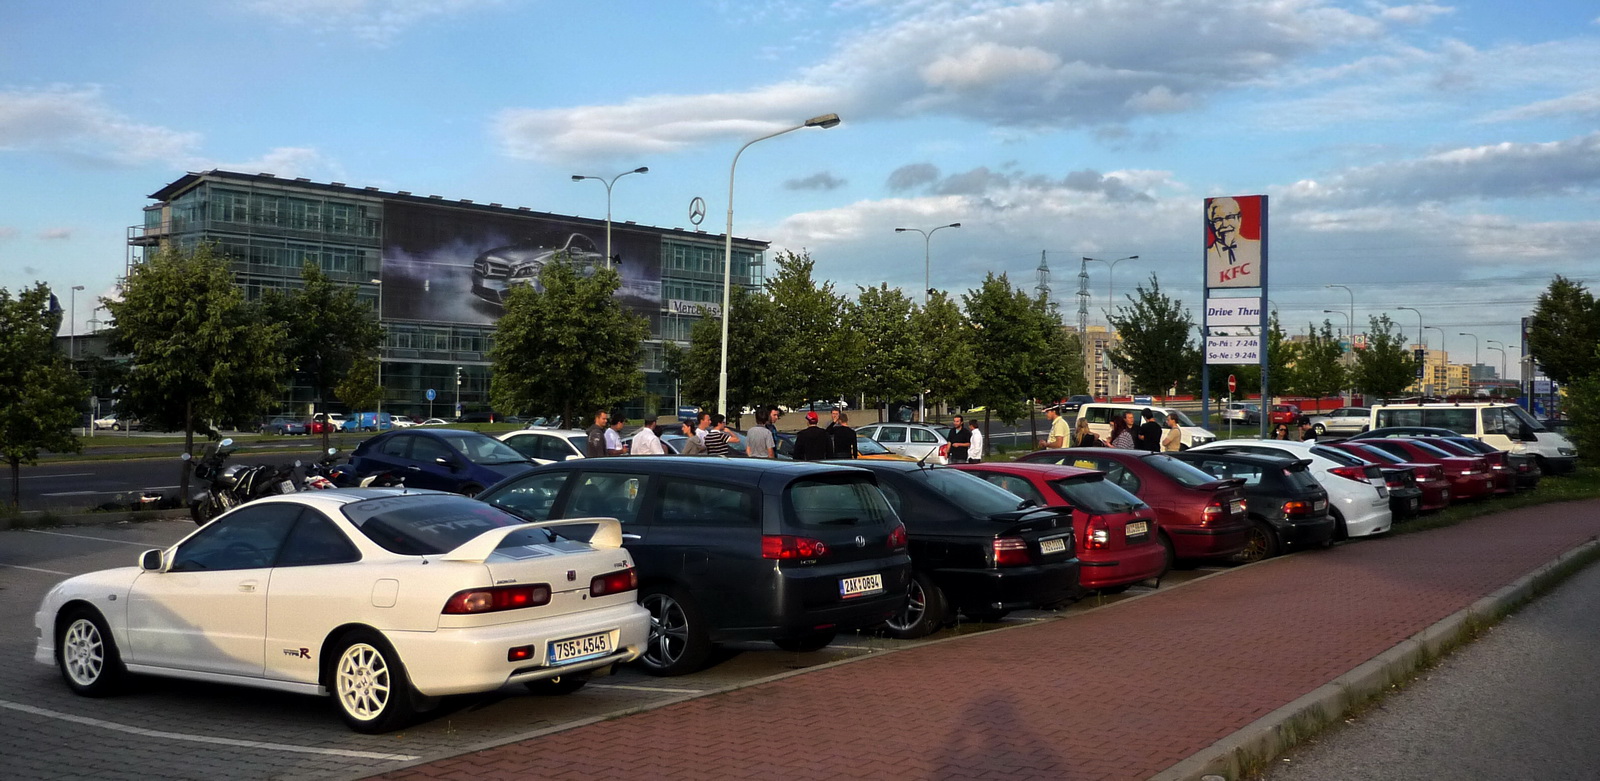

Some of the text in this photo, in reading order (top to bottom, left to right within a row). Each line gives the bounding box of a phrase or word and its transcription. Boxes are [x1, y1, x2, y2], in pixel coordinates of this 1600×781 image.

[1219, 262, 1251, 283] KFC
[1208, 307, 1260, 317] Drive Thru
[300, 648, 311, 659] R
